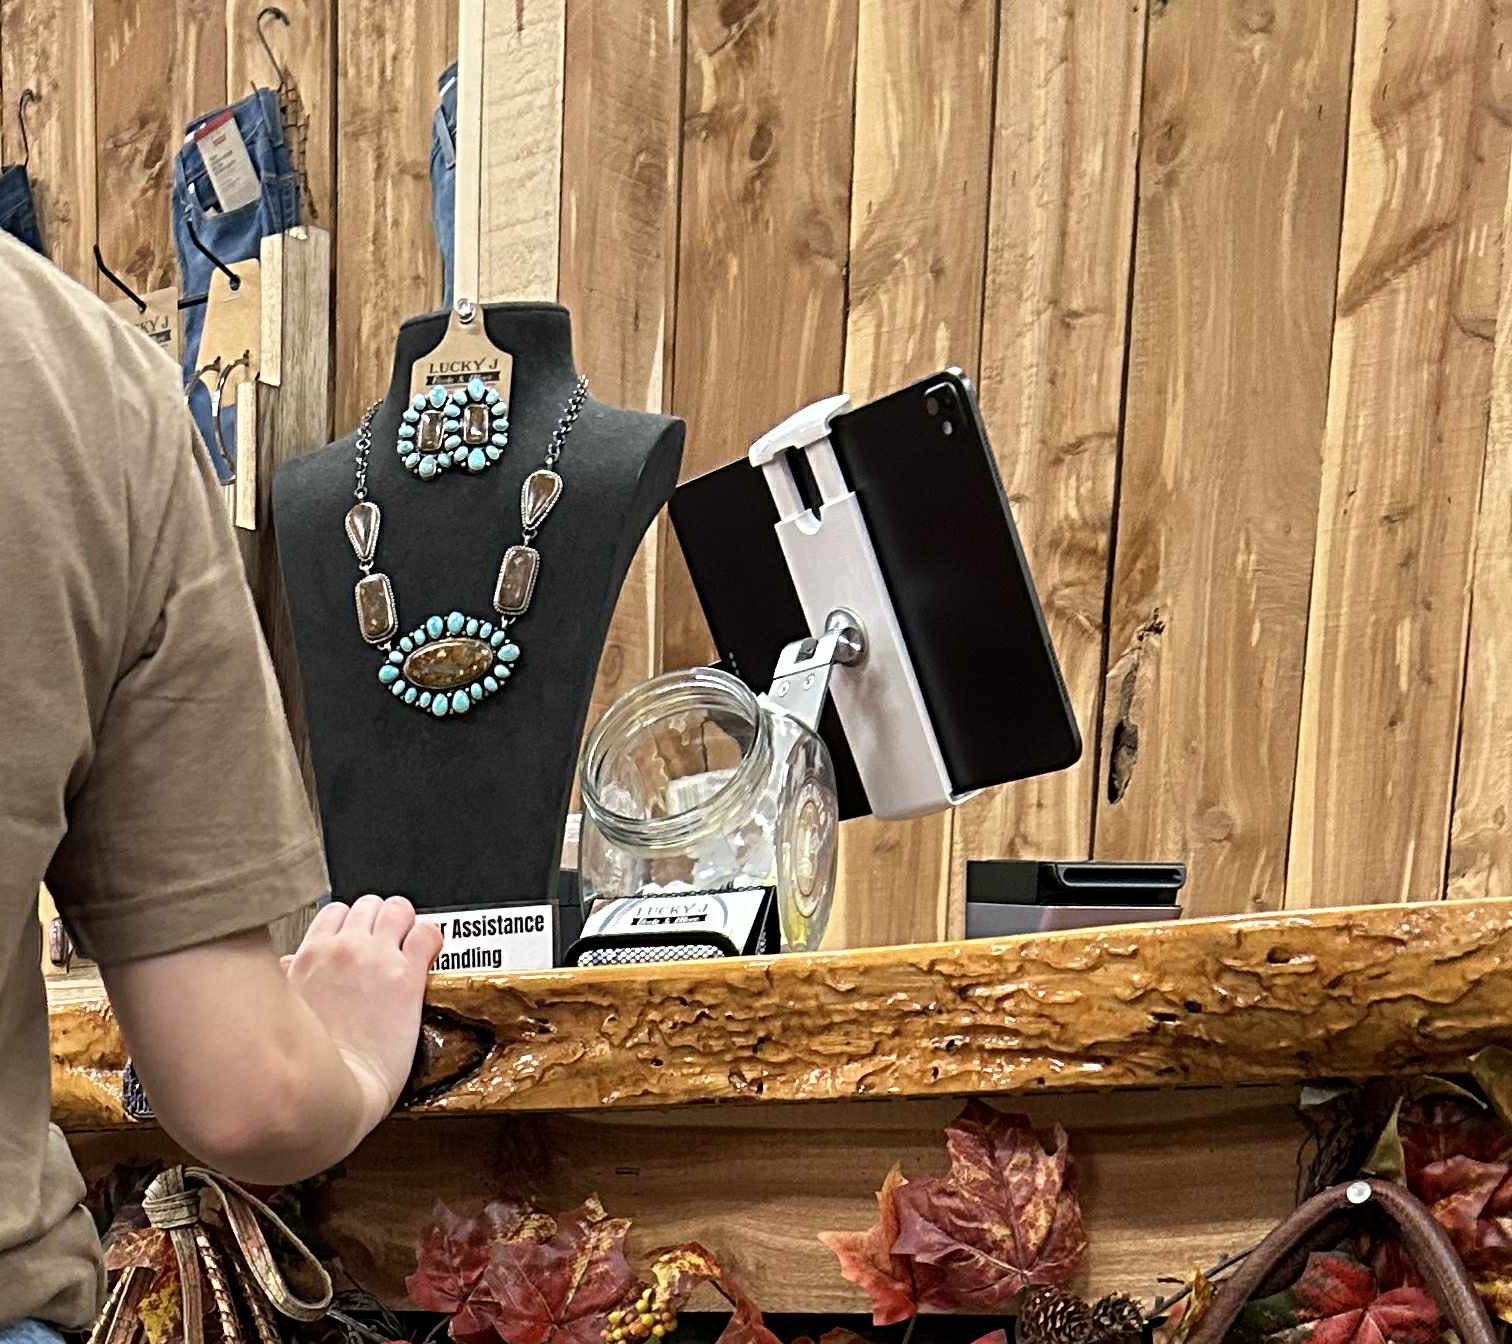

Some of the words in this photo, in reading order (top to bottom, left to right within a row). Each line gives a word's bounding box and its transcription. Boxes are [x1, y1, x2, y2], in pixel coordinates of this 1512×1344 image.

[429, 357, 486, 374] LUCKY
[489, 358, 499, 370] J
[452, 915, 545, 939] Assistance
